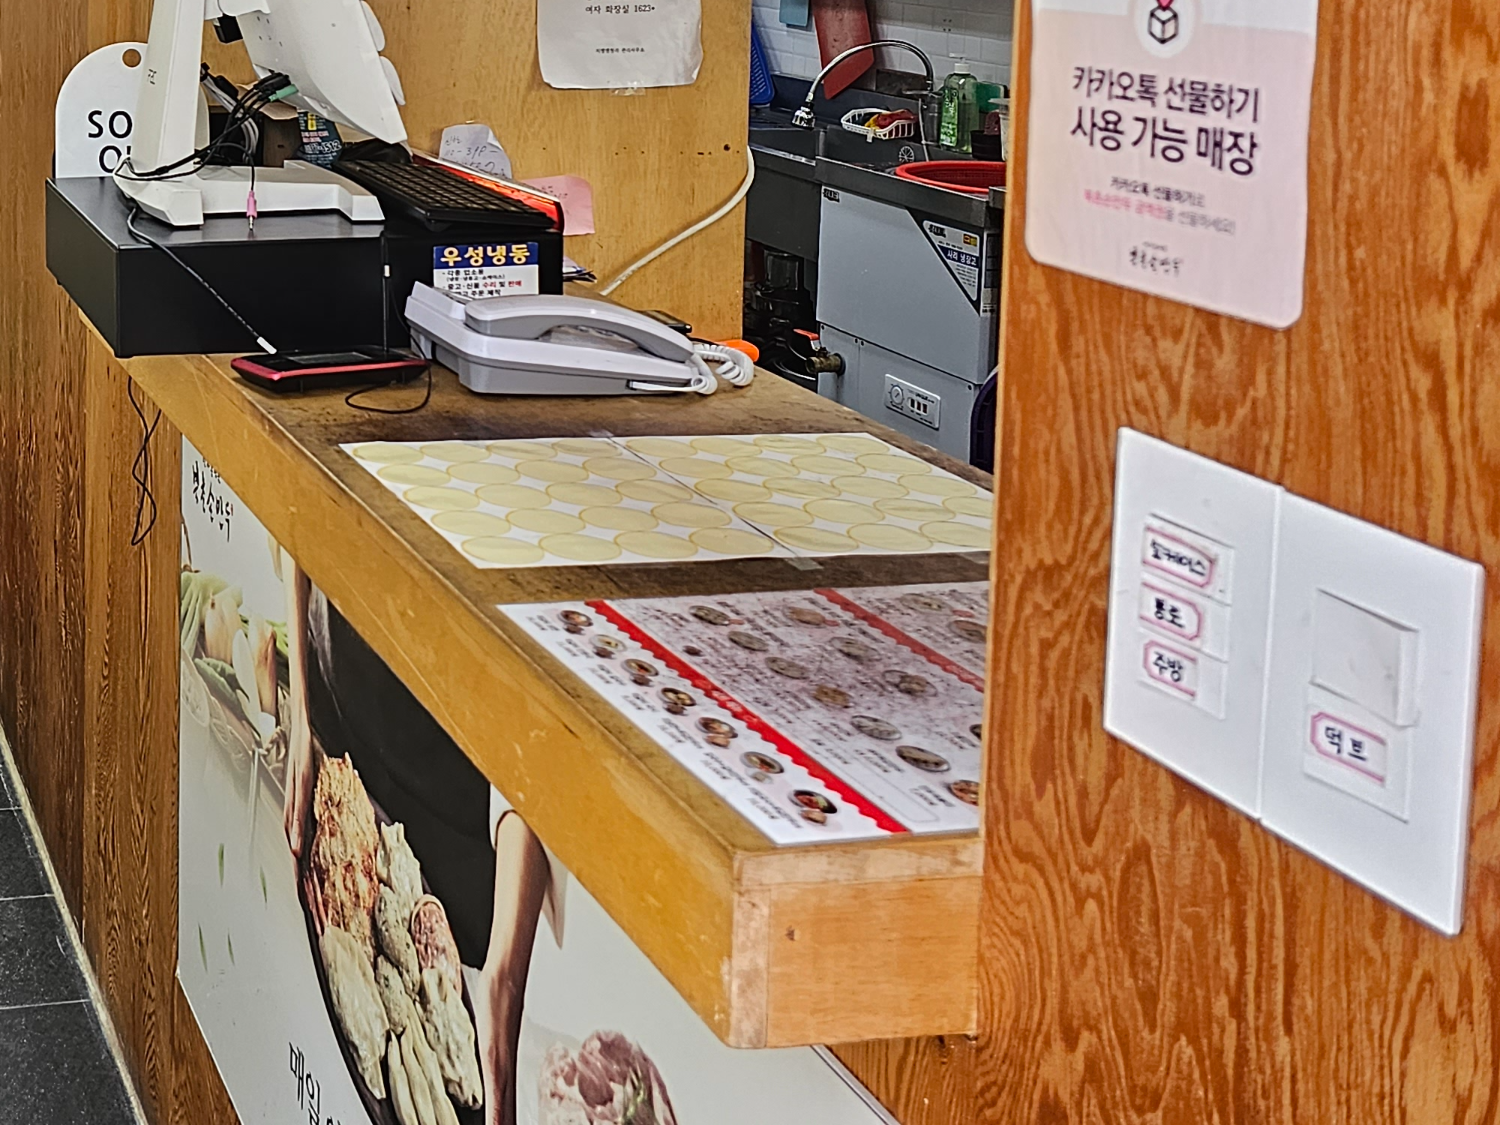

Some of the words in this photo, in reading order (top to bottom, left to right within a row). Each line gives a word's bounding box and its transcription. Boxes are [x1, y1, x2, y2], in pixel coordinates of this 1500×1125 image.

[585, 5, 601, 14] 여자
[605, 4, 630, 14] 화장실
[1073, 65, 1158, 107] 카카오톡
[1163, 77, 1260, 123] 선물하기
[1071, 106, 1125, 152] 사용
[1131, 116, 1188, 164] 가능
[1196, 125, 1258, 176] 매장
[440, 244, 531, 267] 우성냉동
[1154, 597, 1186, 629] 통로
[1152, 651, 1183, 683] 주방
